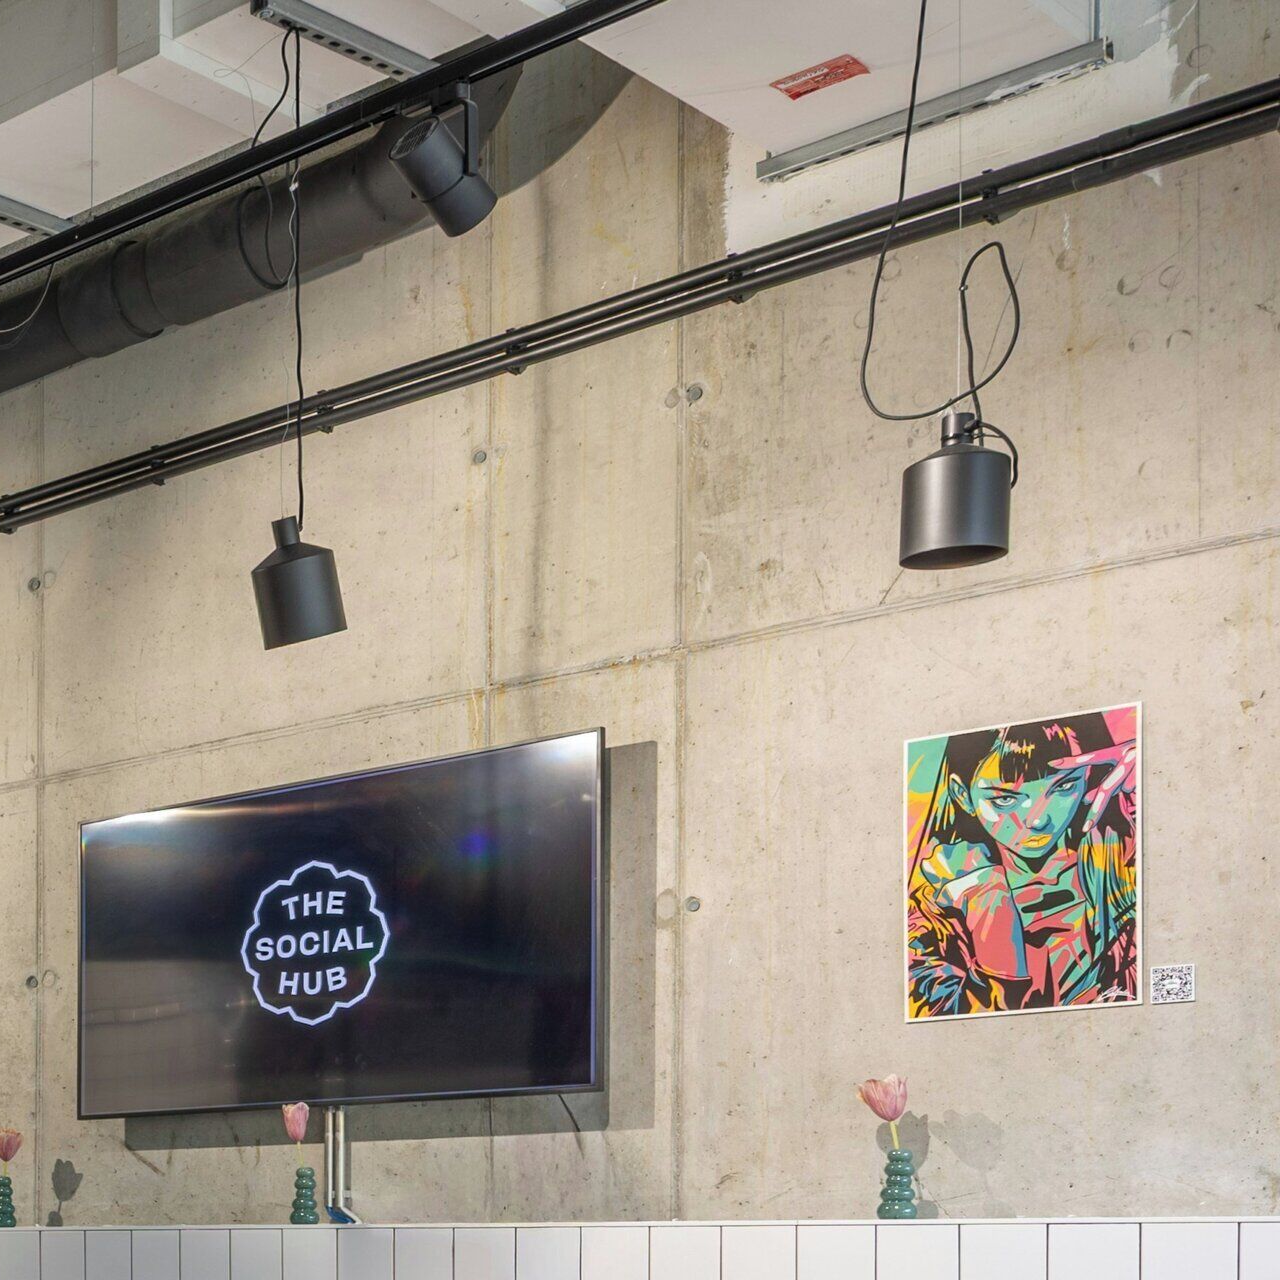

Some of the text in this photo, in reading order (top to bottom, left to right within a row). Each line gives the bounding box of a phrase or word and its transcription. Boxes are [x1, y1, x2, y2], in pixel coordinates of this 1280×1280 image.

[281, 891, 347, 921] THE
[255, 926, 374, 961] SOCIAL
[278, 966, 348, 996] HUB
